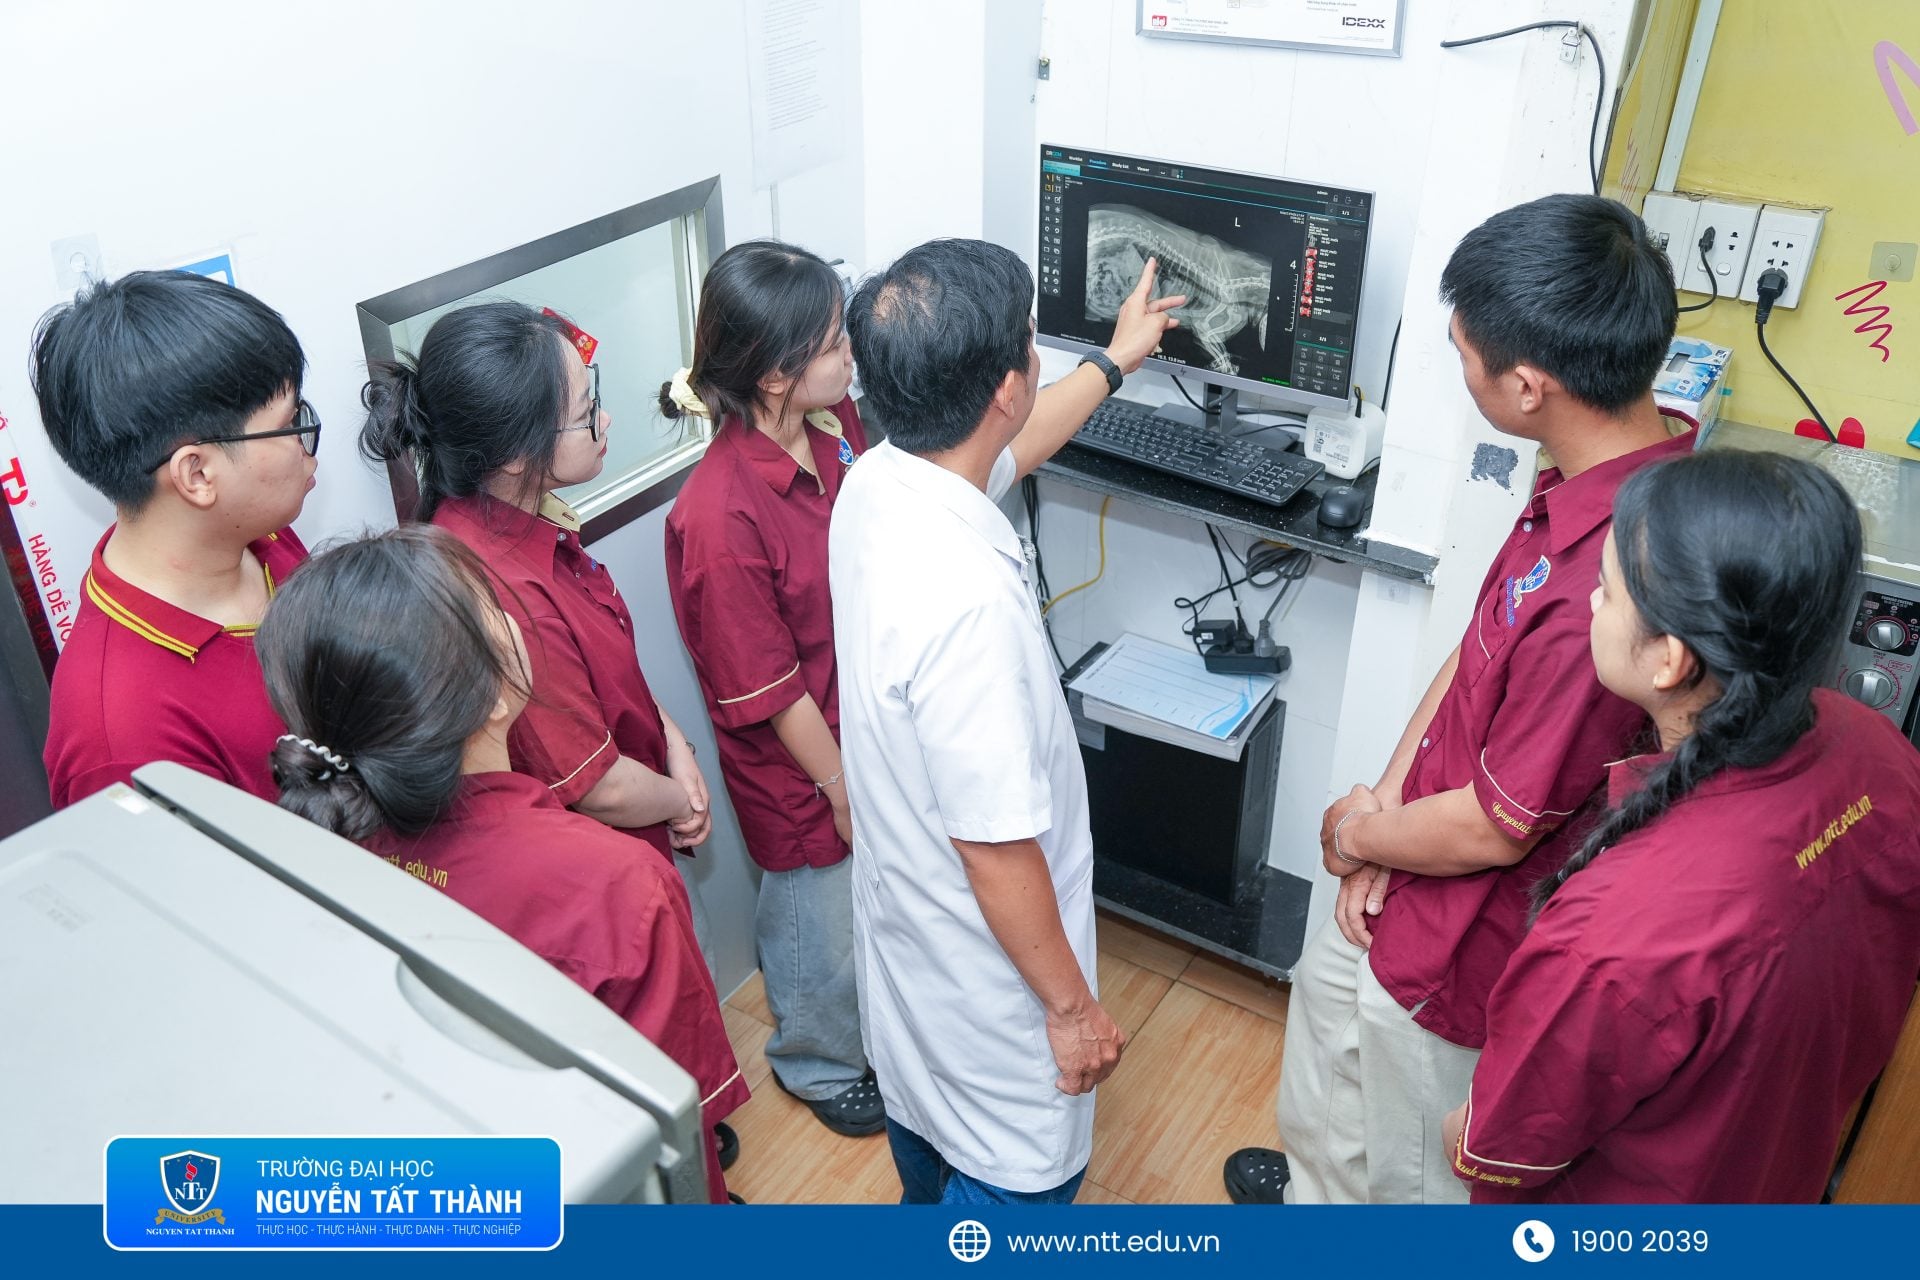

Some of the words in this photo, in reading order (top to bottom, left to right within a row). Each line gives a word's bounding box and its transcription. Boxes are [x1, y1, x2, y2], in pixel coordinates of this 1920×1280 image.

[1341, 16, 1385, 29] IDEXX
[1234, 216, 1241, 228] L
[1289, 260, 1297, 270] 4
[28, 533, 57, 587] HÀNG
[1795, 795, 1872, 869] www.ntt.edu.vn
